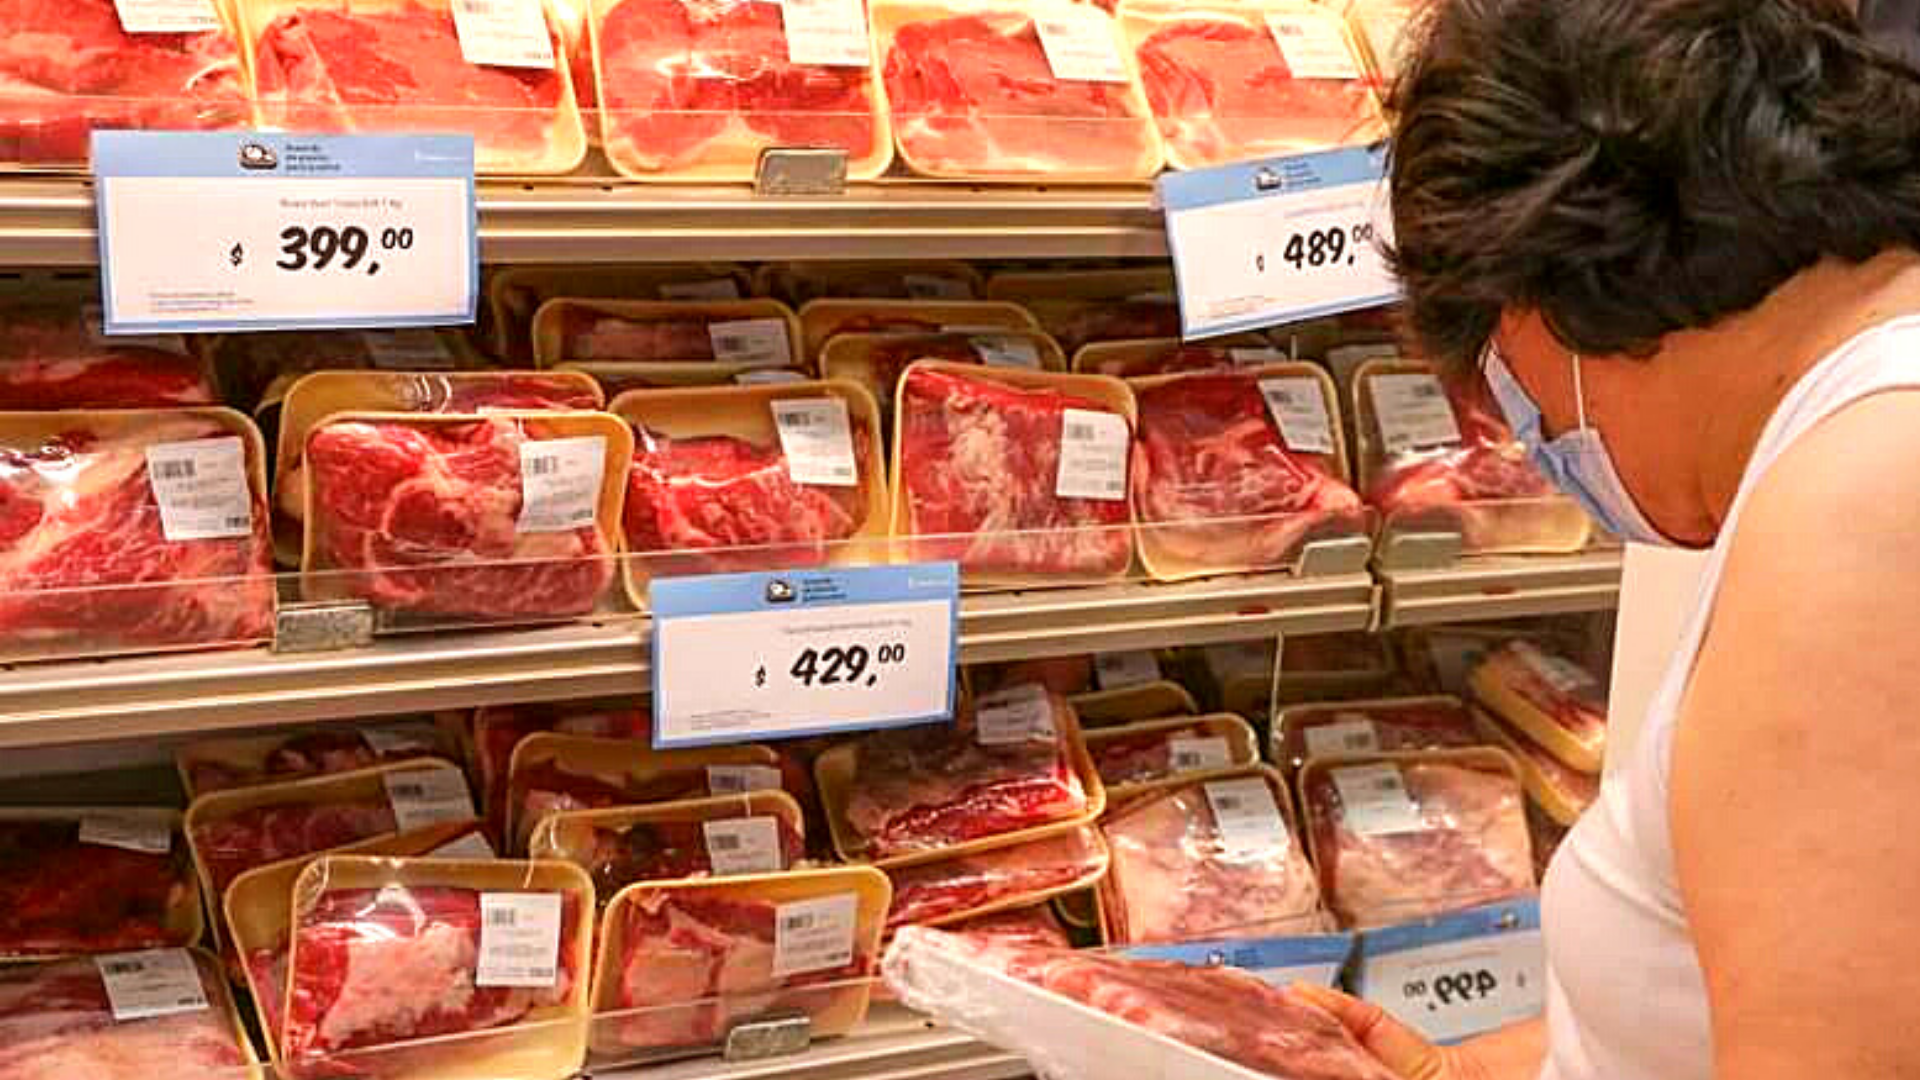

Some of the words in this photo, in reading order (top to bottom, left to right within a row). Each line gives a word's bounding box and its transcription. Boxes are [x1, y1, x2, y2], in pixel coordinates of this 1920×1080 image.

[230, 242, 244, 266] $
[275, 226, 414, 276] 399,00
[754, 665, 766, 688] $
[789, 643, 905, 687] 429,00
